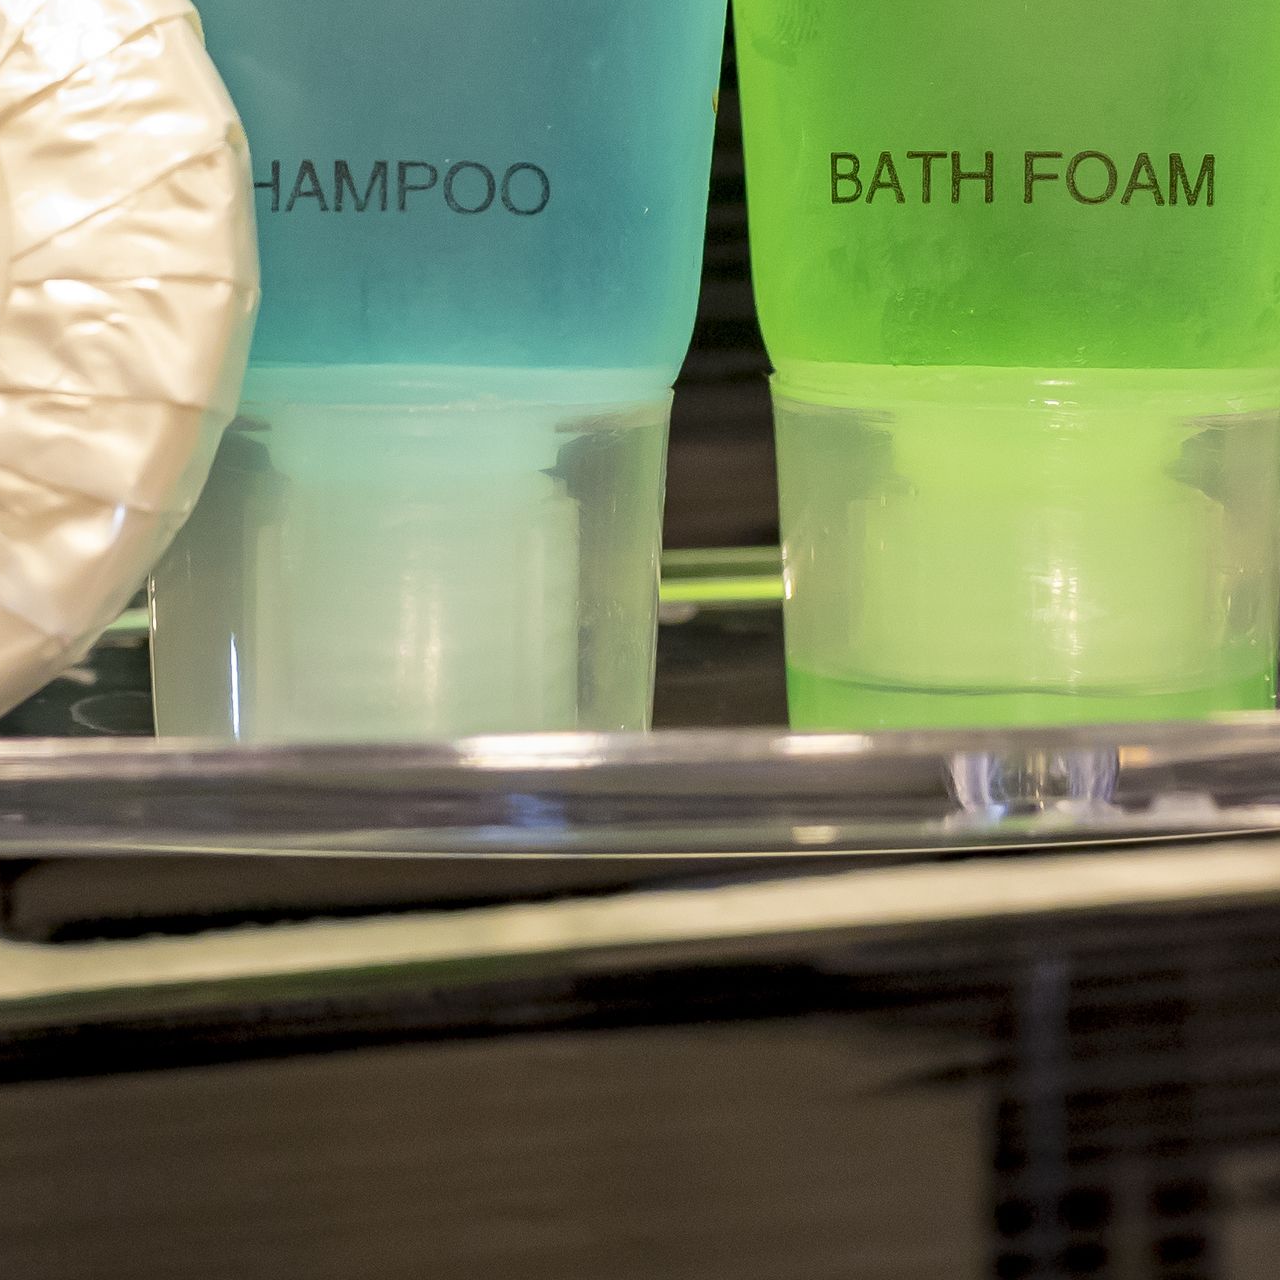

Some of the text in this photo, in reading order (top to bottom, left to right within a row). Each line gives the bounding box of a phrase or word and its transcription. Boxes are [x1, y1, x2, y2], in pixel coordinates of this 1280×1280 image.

[253, 159, 551, 216] HAMPOO
[830, 150, 1215, 207] BATH FOAM
